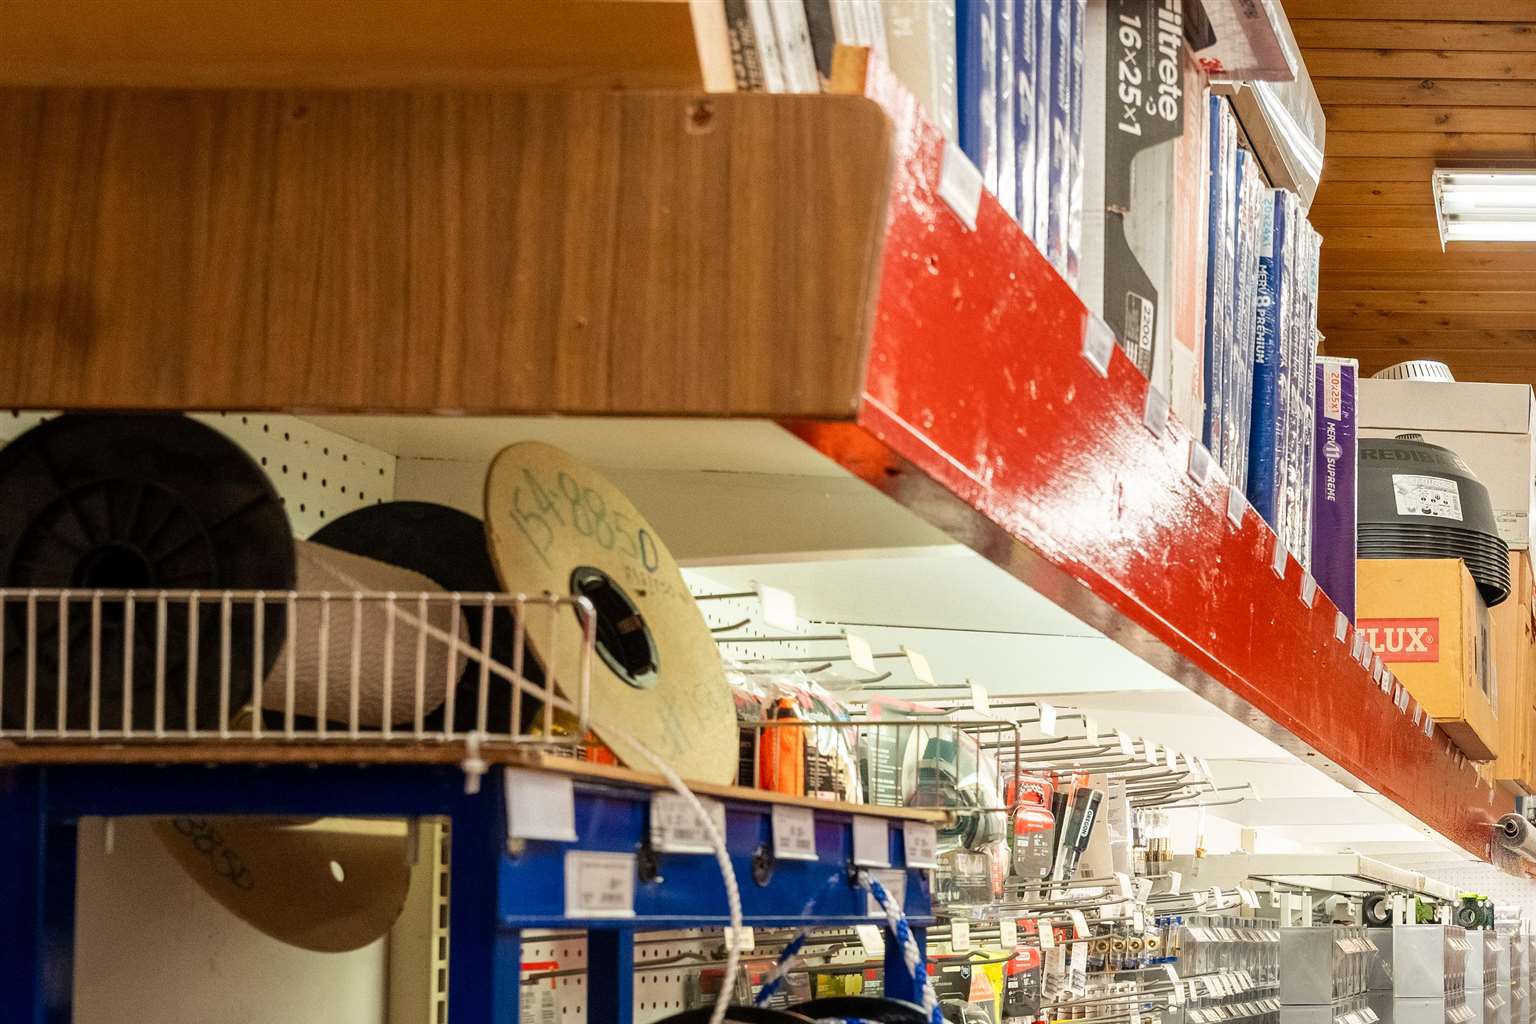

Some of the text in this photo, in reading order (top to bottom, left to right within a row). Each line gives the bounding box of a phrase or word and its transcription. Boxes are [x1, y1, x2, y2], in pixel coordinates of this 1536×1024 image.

[1258, 264, 1267, 289] MERV
[1255, 309, 1266, 364] PREMIUM
[1326, 421, 1336, 448] MERV
[1326, 457, 1336, 503] SUPREME
